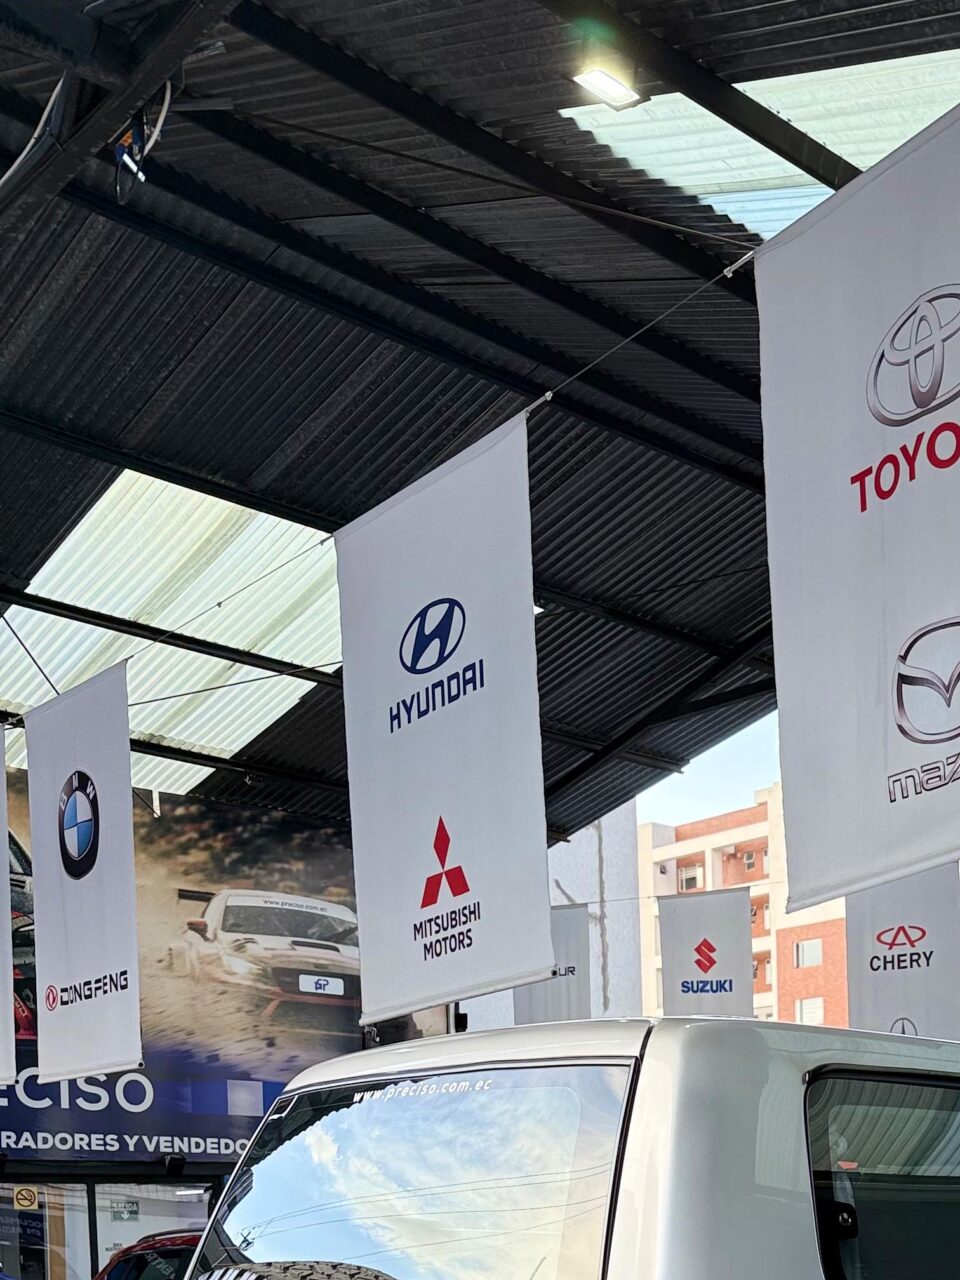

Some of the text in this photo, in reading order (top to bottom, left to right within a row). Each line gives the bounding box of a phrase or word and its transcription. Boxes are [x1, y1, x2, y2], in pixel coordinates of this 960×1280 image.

[389, 659, 485, 734] HYUNDAI
[59, 771, 97, 811] BMW
[413, 902, 481, 941] MITSUBISHI
[423, 928, 473, 961] MOTORS
[869, 951, 934, 972] CHERY
[60, 970, 128, 1006] DONGFENG
[681, 979, 733, 994] SUZUKI
[353, 1079, 493, 1103] www.preciso.com.ec
[122, 1134, 139, 1152] Y
